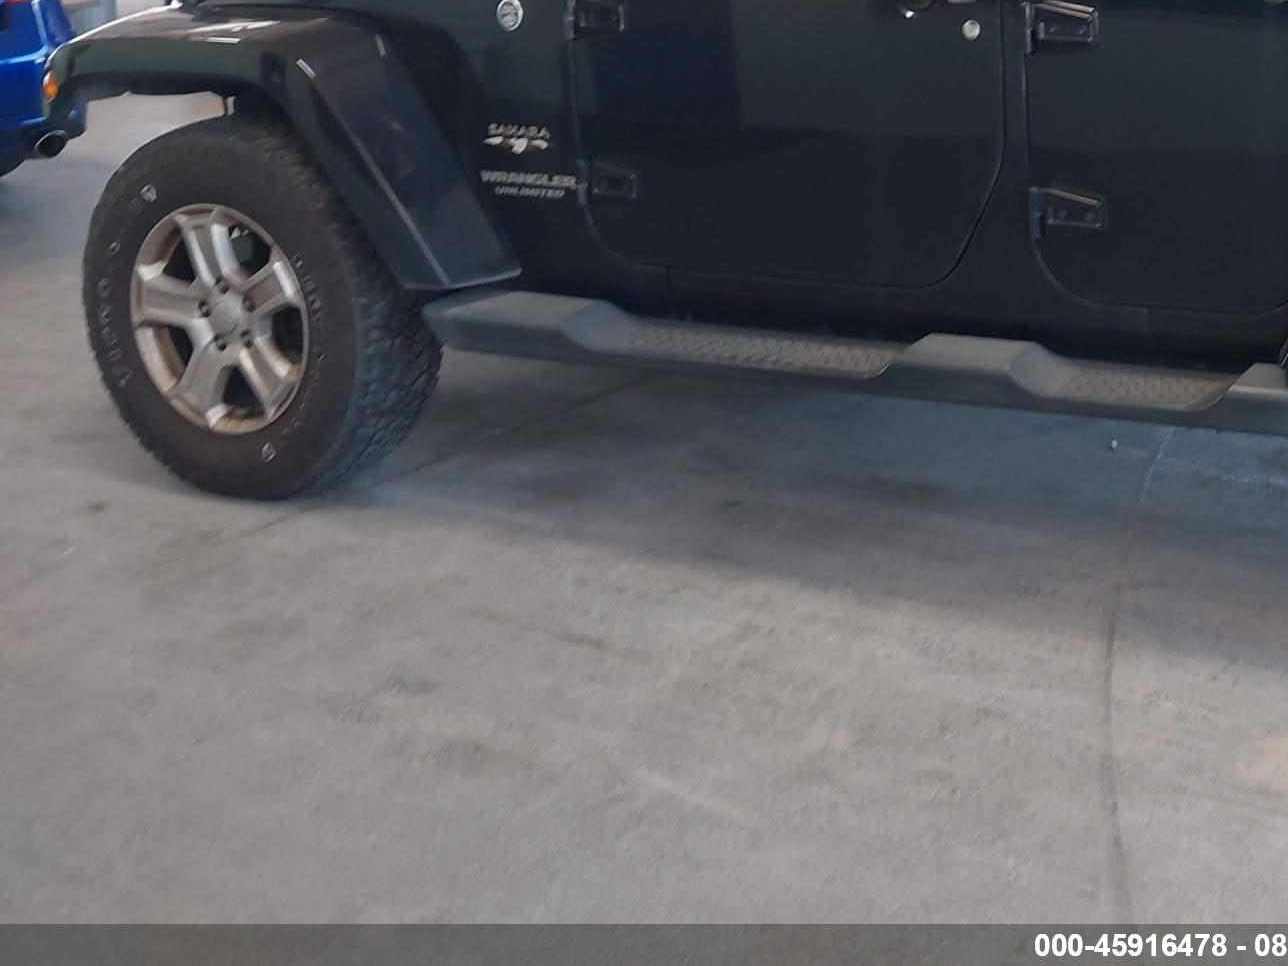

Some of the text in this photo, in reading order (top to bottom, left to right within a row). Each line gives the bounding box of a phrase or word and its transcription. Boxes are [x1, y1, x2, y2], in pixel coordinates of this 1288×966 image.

[488, 123, 551, 140] SAHARA
[480, 170, 577, 190] WRANGLER
[494, 185, 566, 200] UNLIMITED
